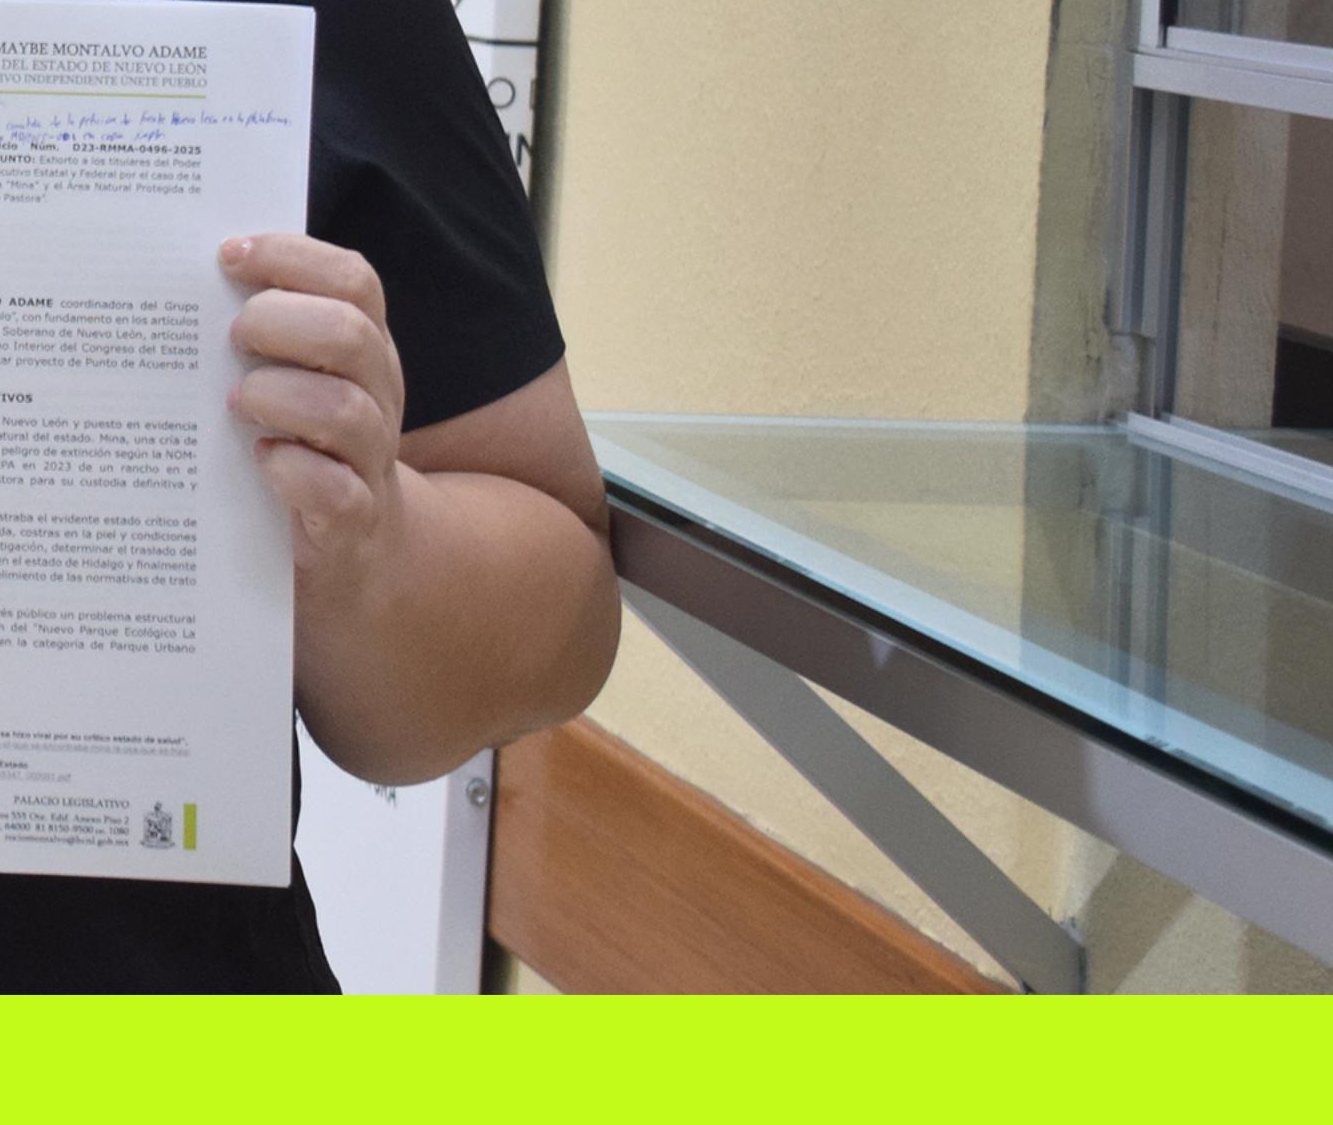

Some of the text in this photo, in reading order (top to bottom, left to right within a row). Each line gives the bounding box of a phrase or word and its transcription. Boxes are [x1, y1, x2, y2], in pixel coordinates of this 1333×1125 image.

[52, 42, 145, 58] MONTALVO
[148, 45, 208, 60] ADAME
[0, 57, 29, 71] DEL
[31, 58, 89, 73] ESTADO
[91, 60, 111, 73] DE
[114, 61, 166, 74] NUEVO
[168, 62, 208, 75] LEÓN
[23, 74, 118, 86] INDEPENDIENTE
[120, 75, 159, 87] ÚNETE
[161, 76, 209, 89] PUEBLO
[27, 141, 59, 152] Núm.
[72, 143, 202, 155] D23-RMMA-0496-2025
[8, 297, 54, 307] ADAME
[60, 300, 134, 310] coordinadora
[140, 301, 158, 311] del
[164, 301, 199, 313] Grupo
[13, 795, 131, 810] PALACIO LEGISLATIVO
